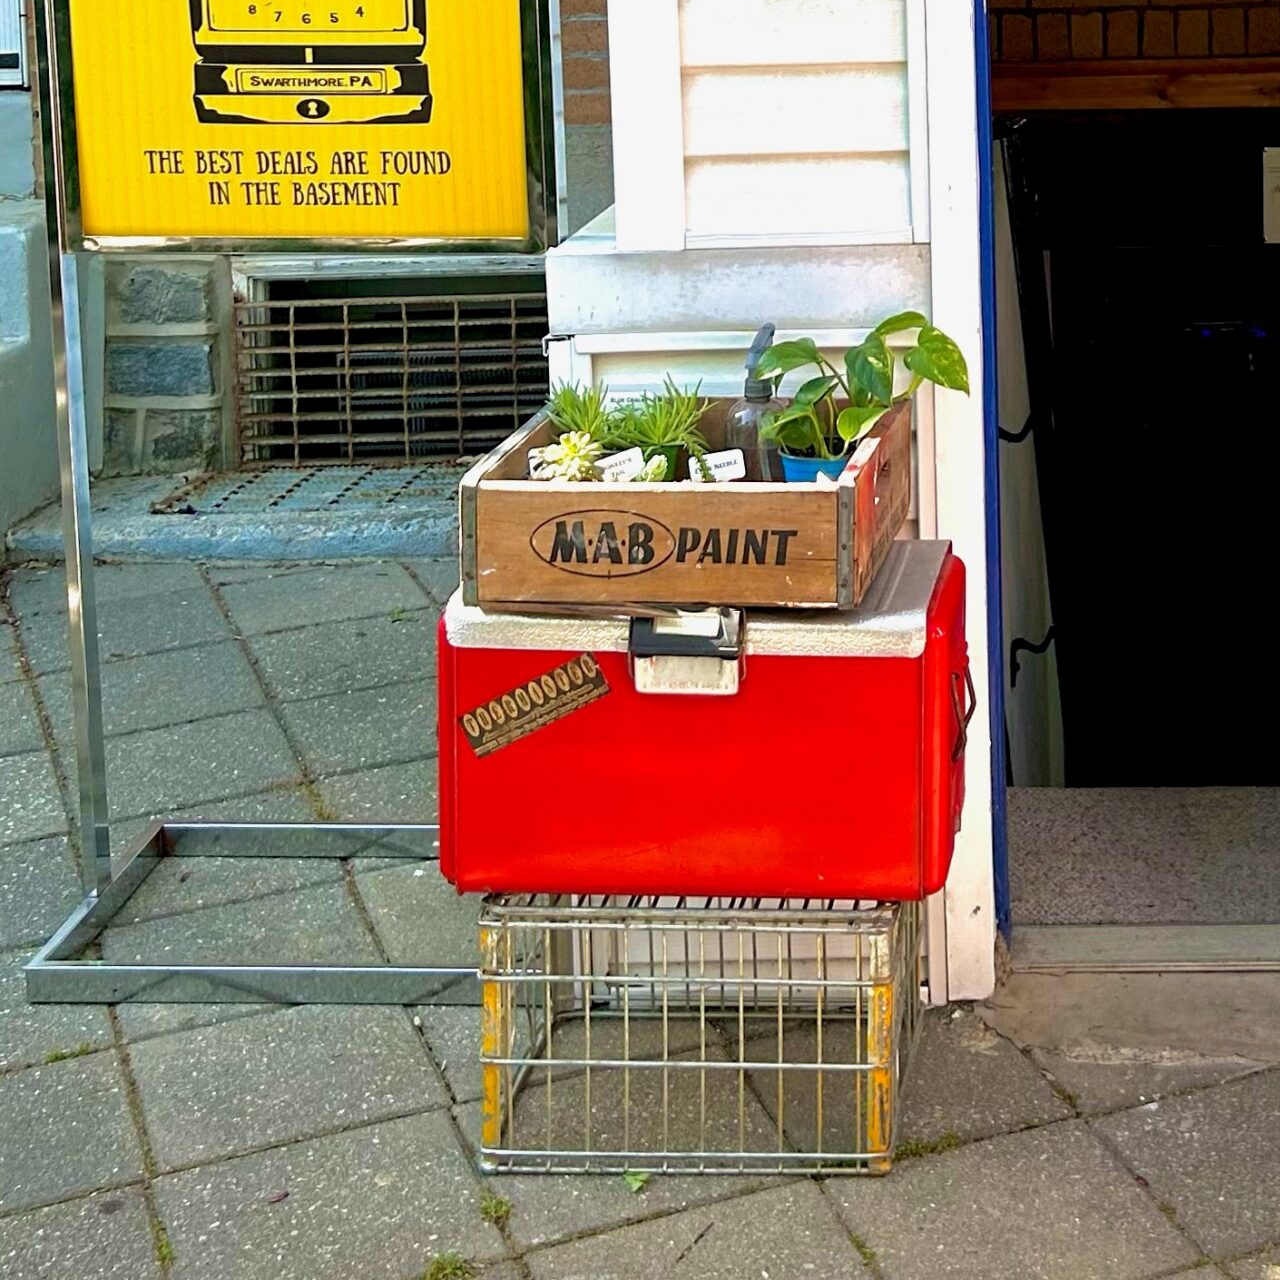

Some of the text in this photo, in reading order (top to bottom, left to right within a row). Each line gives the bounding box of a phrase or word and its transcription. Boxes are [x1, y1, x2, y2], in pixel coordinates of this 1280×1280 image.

[248, 4, 257, 15] 8
[355, 6, 364, 17] 4
[274, 11, 282, 22] 7
[301, 13, 311, 24] 6
[330, 12, 339, 23] 5
[349, 75, 373, 87] PA
[143, 150, 452, 175] THE BEST DEALS ARE FOUND
[208, 181, 401, 206] IN THE BASEMENT
[676, 527, 799, 566] PAINT
